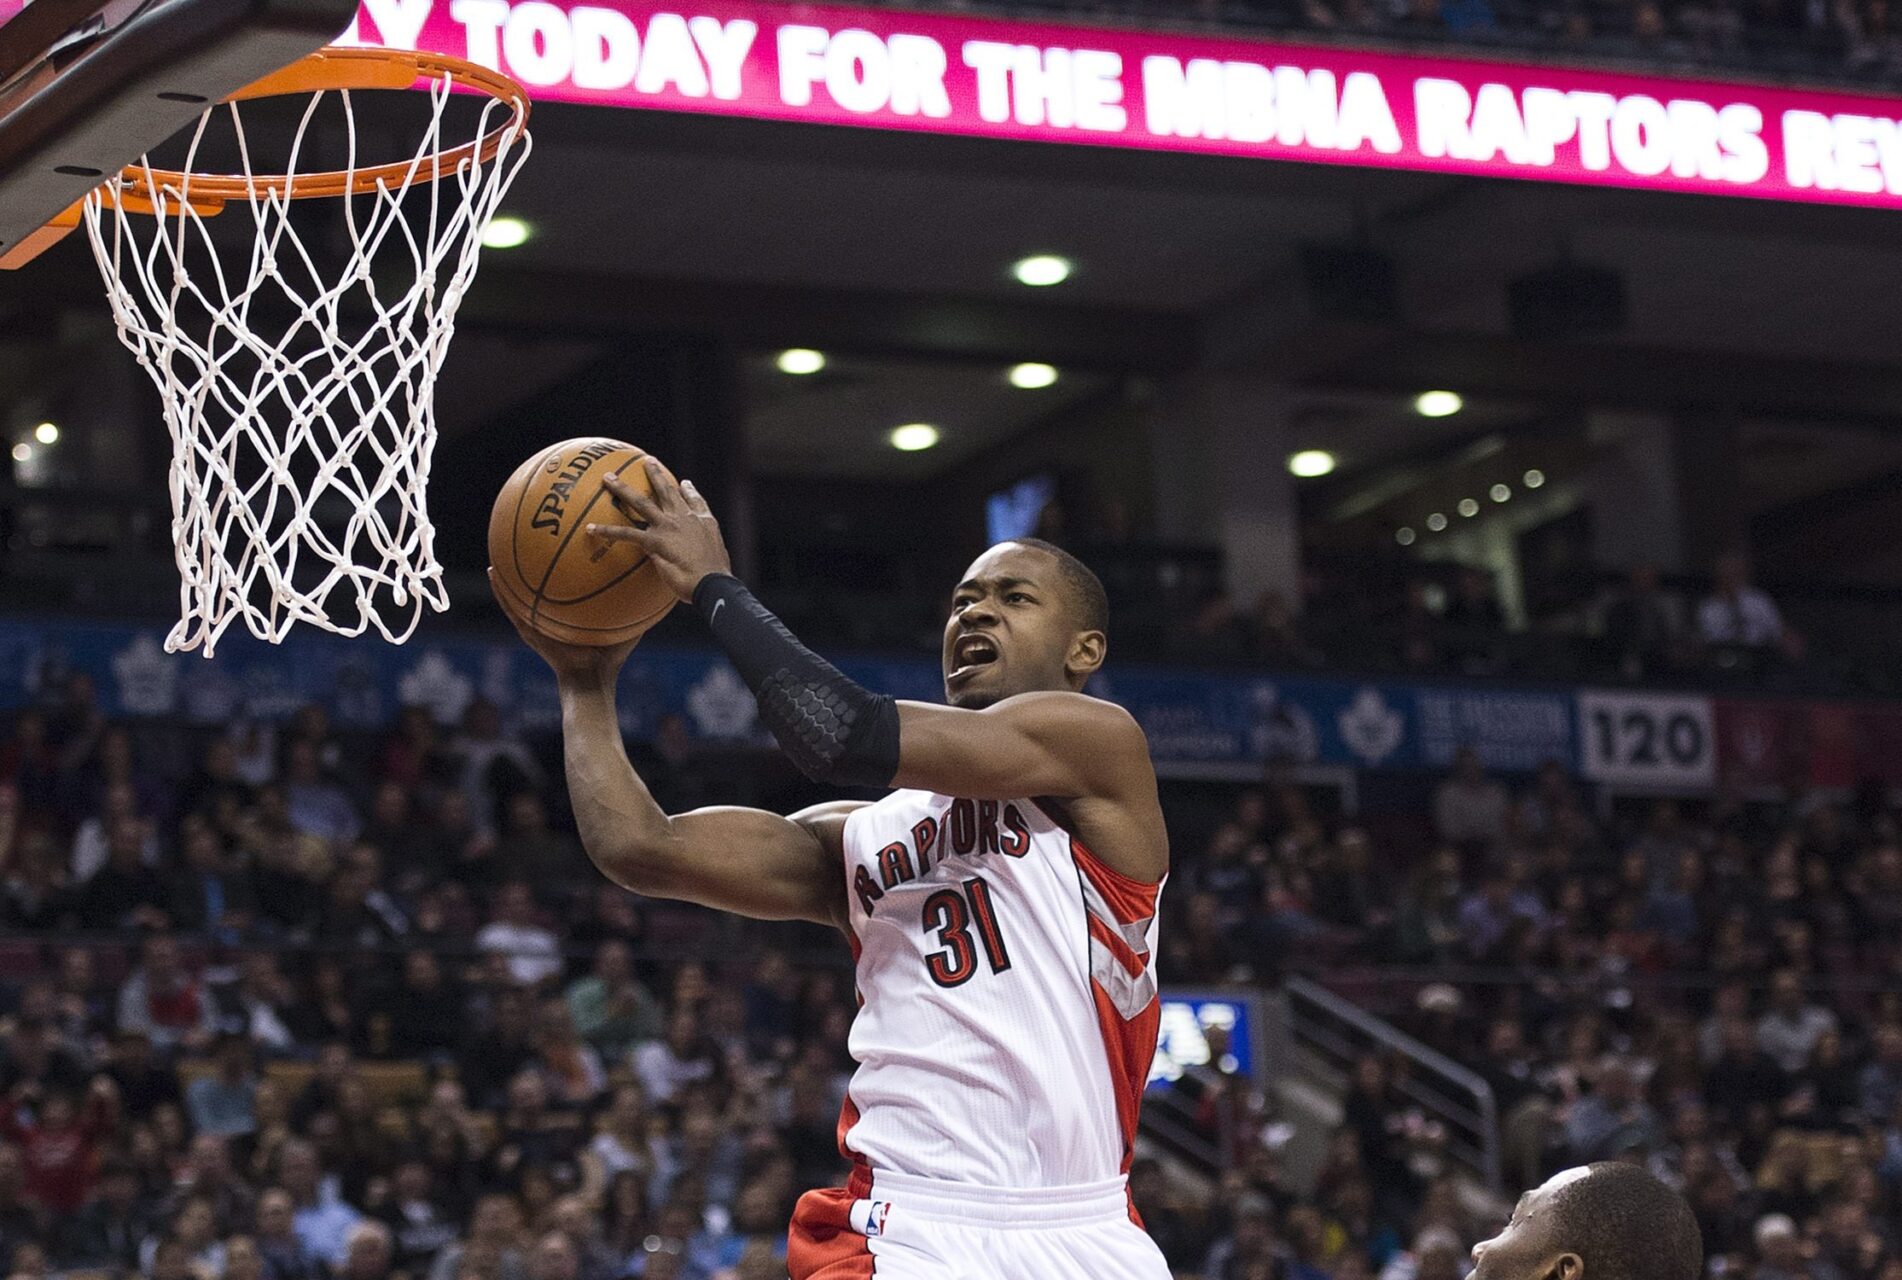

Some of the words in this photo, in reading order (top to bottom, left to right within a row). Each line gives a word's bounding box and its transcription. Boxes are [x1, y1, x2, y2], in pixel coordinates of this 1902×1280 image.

[452, 0, 758, 100] TODAY
[777, 24, 951, 118] FOR
[963, 40, 1127, 131] THE
[1413, 77, 1768, 183] RAPTORS
[1593, 707, 1703, 768] 120
[854, 797, 1031, 918] RAPTORS
[922, 876, 1011, 989] 31
